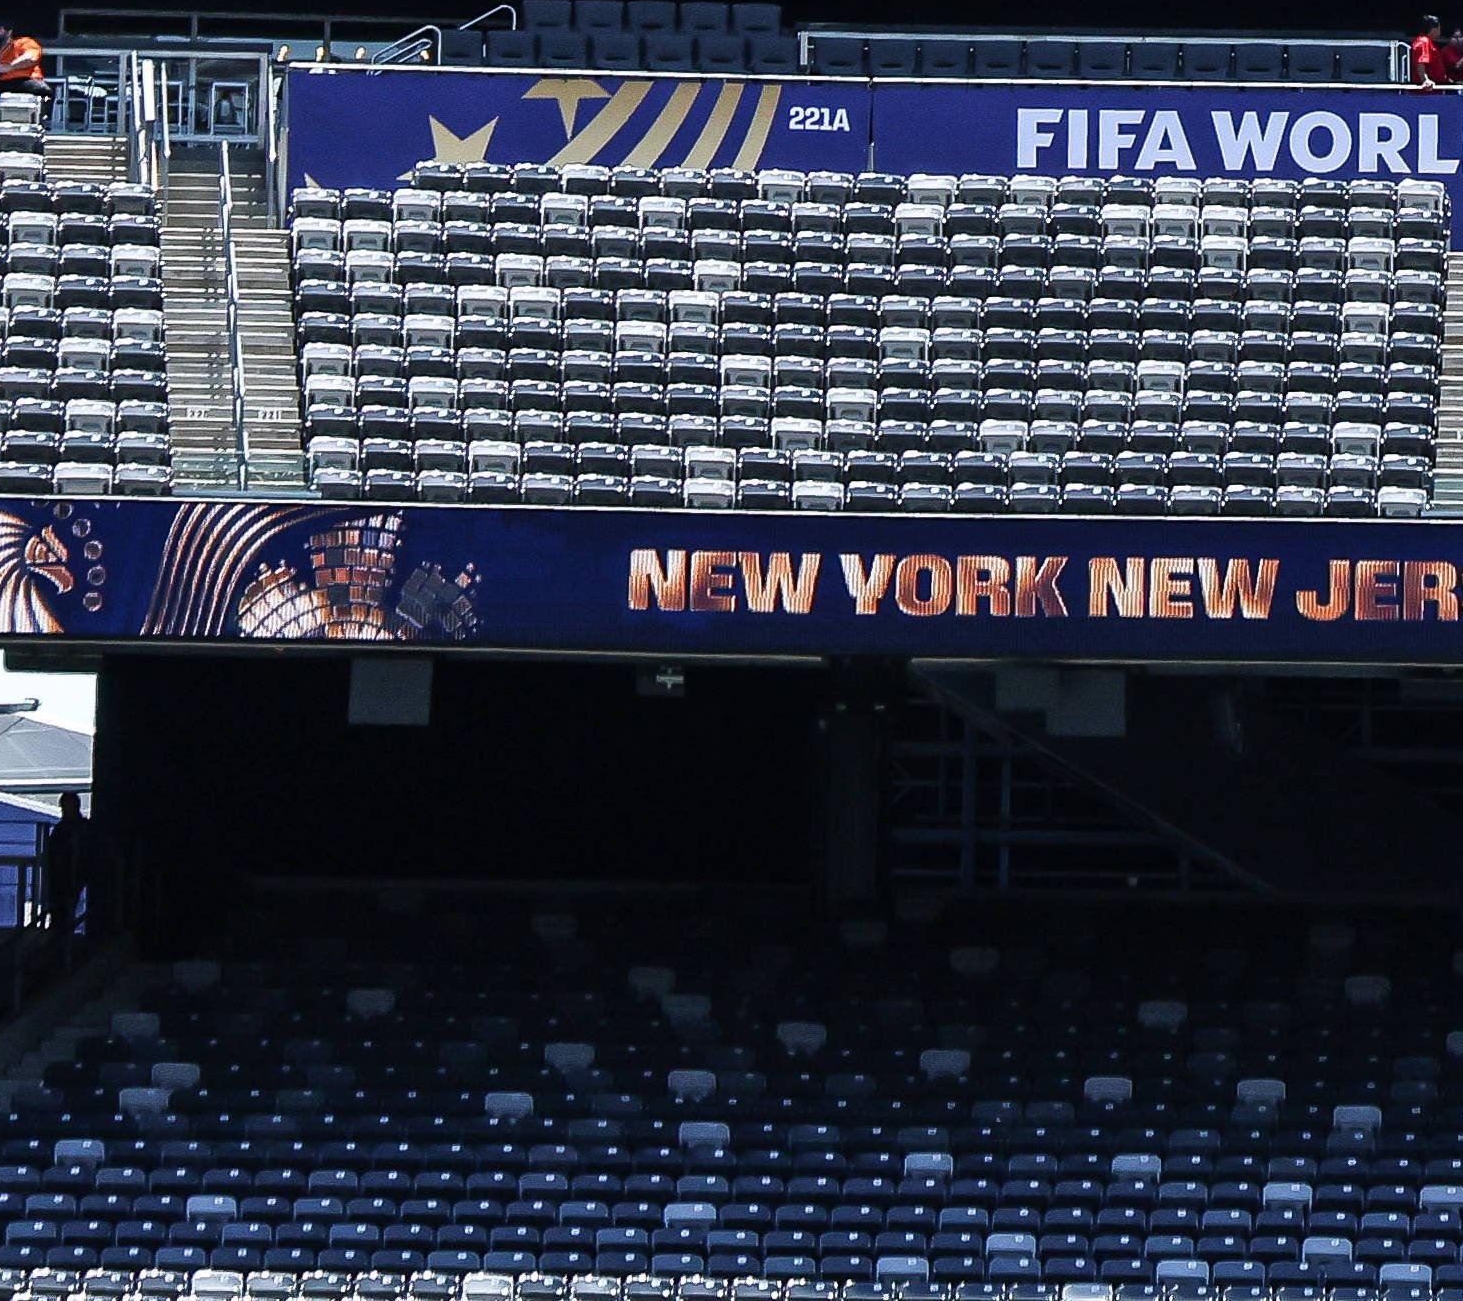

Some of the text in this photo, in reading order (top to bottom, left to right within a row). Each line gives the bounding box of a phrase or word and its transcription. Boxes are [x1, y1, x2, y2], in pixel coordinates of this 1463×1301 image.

[790, 107, 849, 131] 221A
[1017, 109, 1196, 170] FIFA
[629, 549, 820, 614] NEW
[840, 553, 1069, 616] YORK
[1089, 557, 1280, 619] NEW
